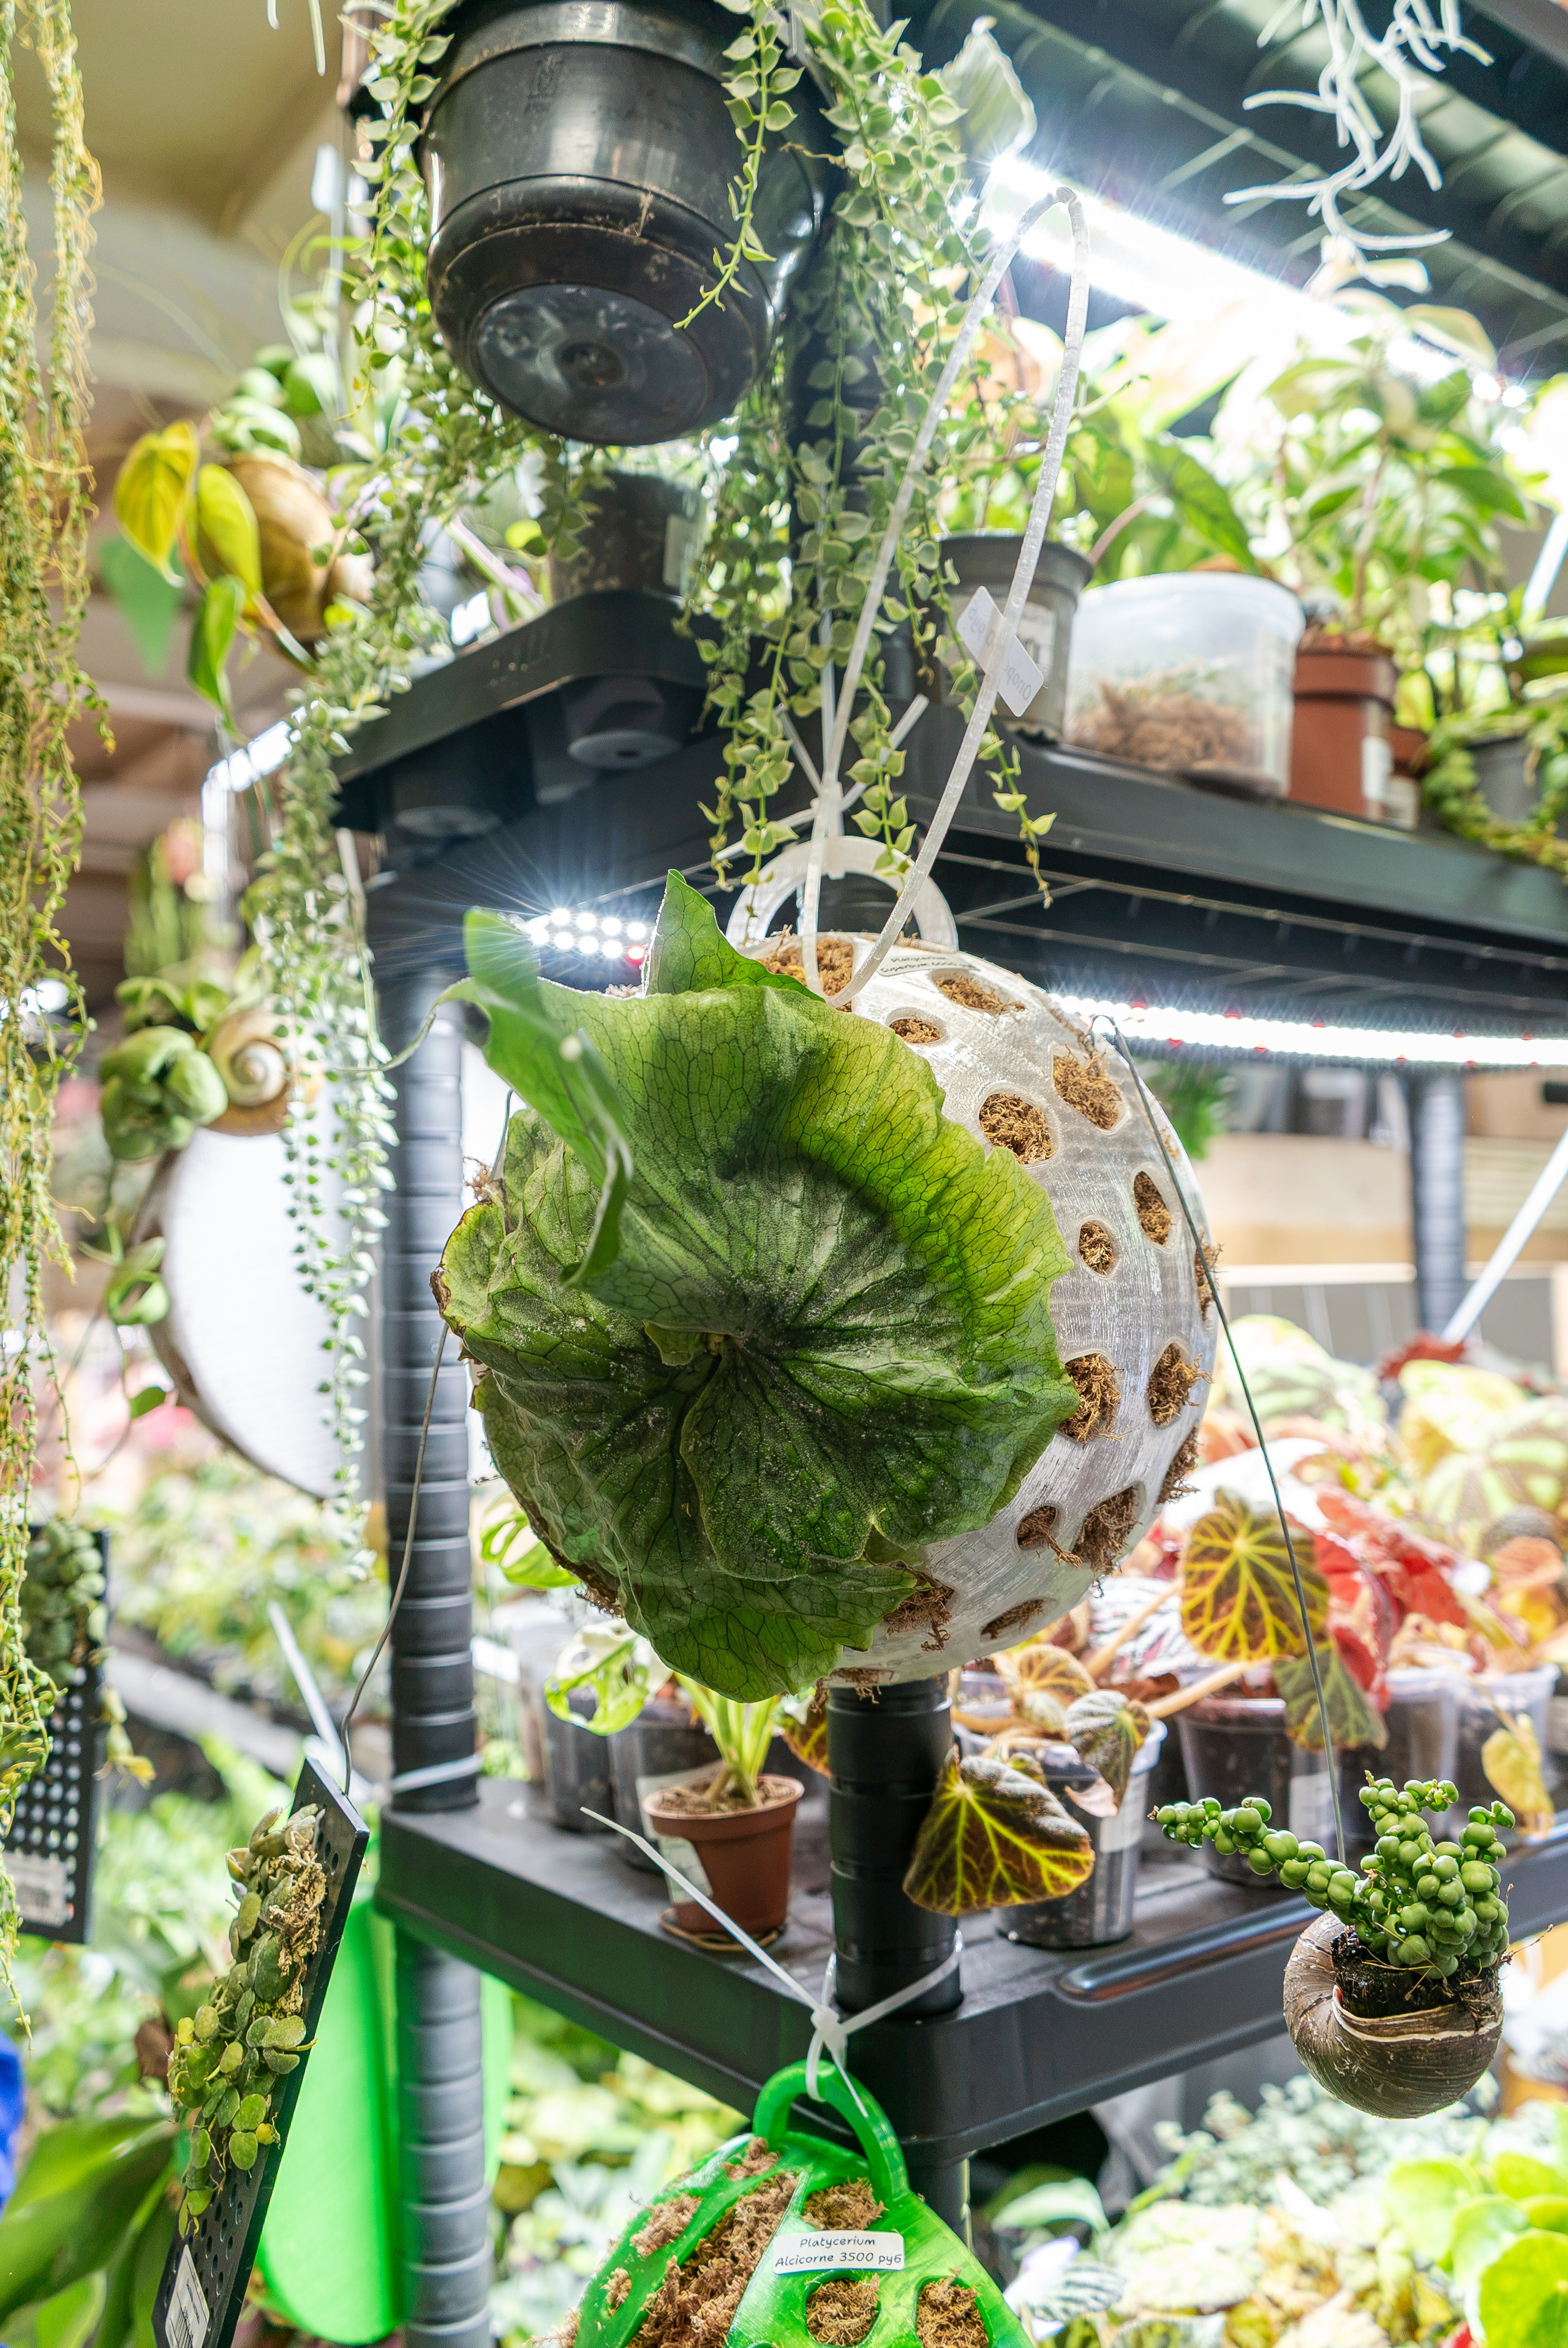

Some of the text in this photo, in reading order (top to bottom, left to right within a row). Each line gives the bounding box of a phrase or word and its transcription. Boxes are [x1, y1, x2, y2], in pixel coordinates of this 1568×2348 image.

[800, 2235, 875, 2249] Platycerium
[775, 2252, 902, 2267] Alcicorne 3500 руб
